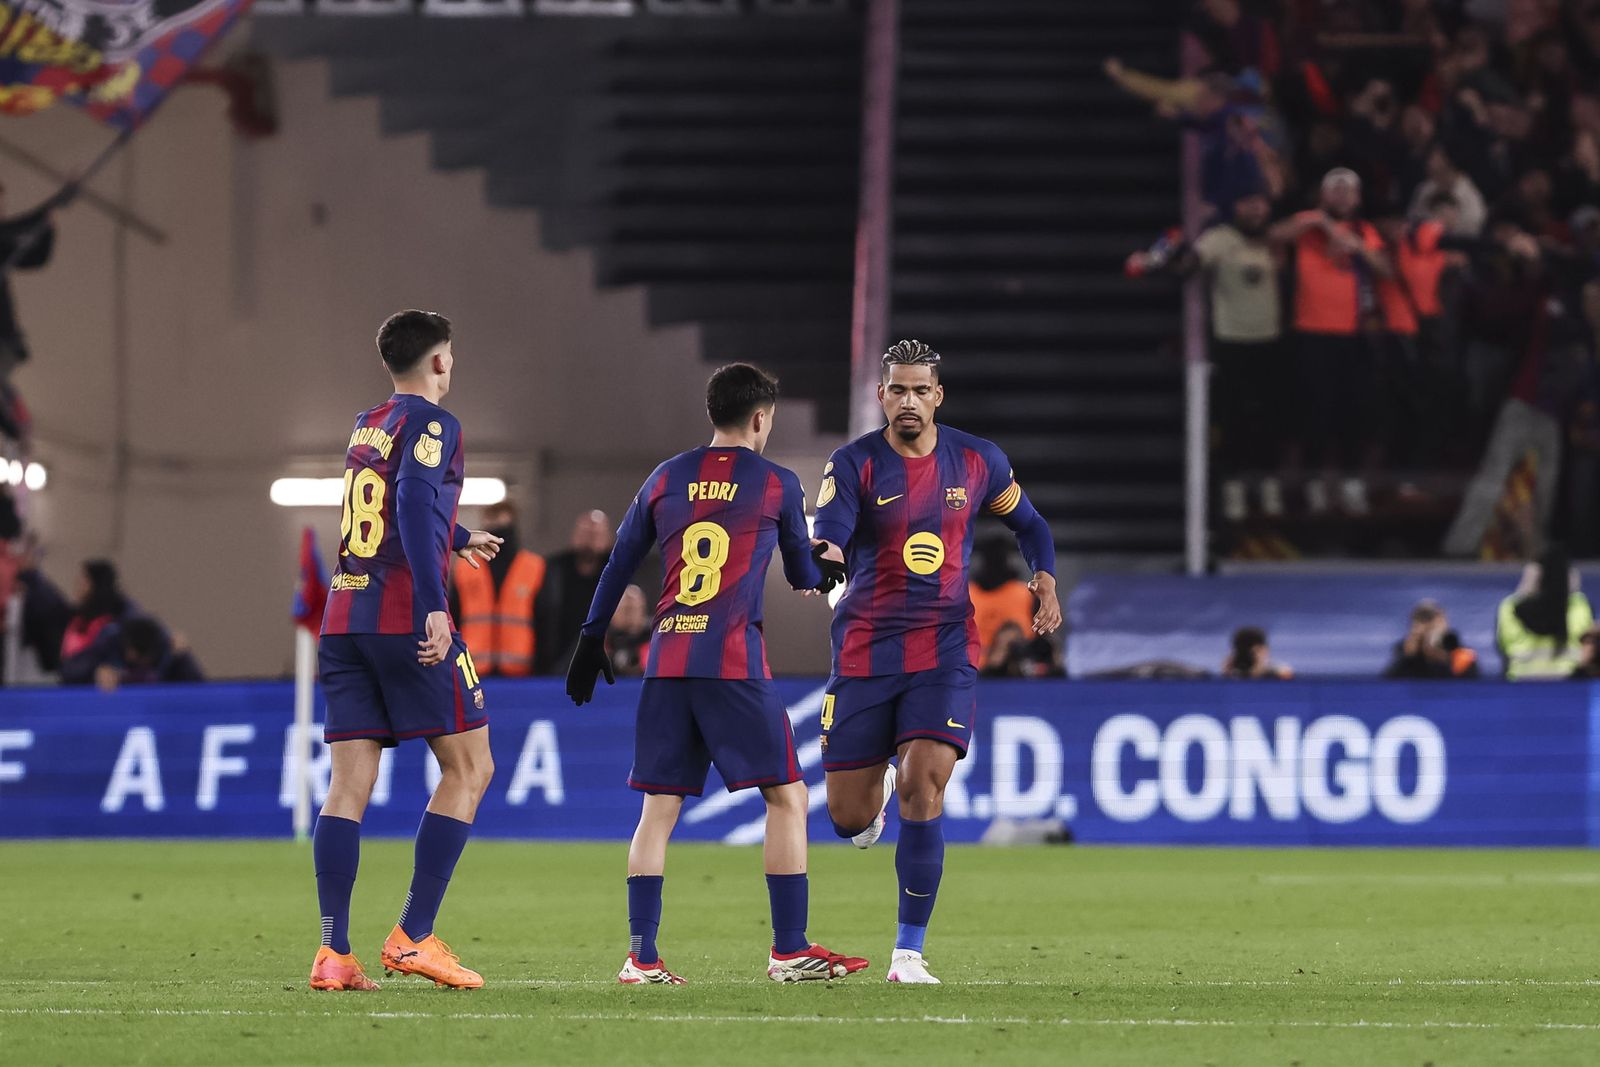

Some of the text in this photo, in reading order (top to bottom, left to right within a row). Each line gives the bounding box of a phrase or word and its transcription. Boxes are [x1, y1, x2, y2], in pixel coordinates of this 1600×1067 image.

[341, 467, 386, 558] 18
[688, 481, 739, 502] PEDRI
[675, 521, 730, 607] 8
[674, 622, 708, 631] ACNUR
[675, 614, 709, 623] UNHCR
[820, 693, 836, 731] 4
[101, 720, 564, 812] AFRIA
[1091, 713, 1448, 823] CONGO
